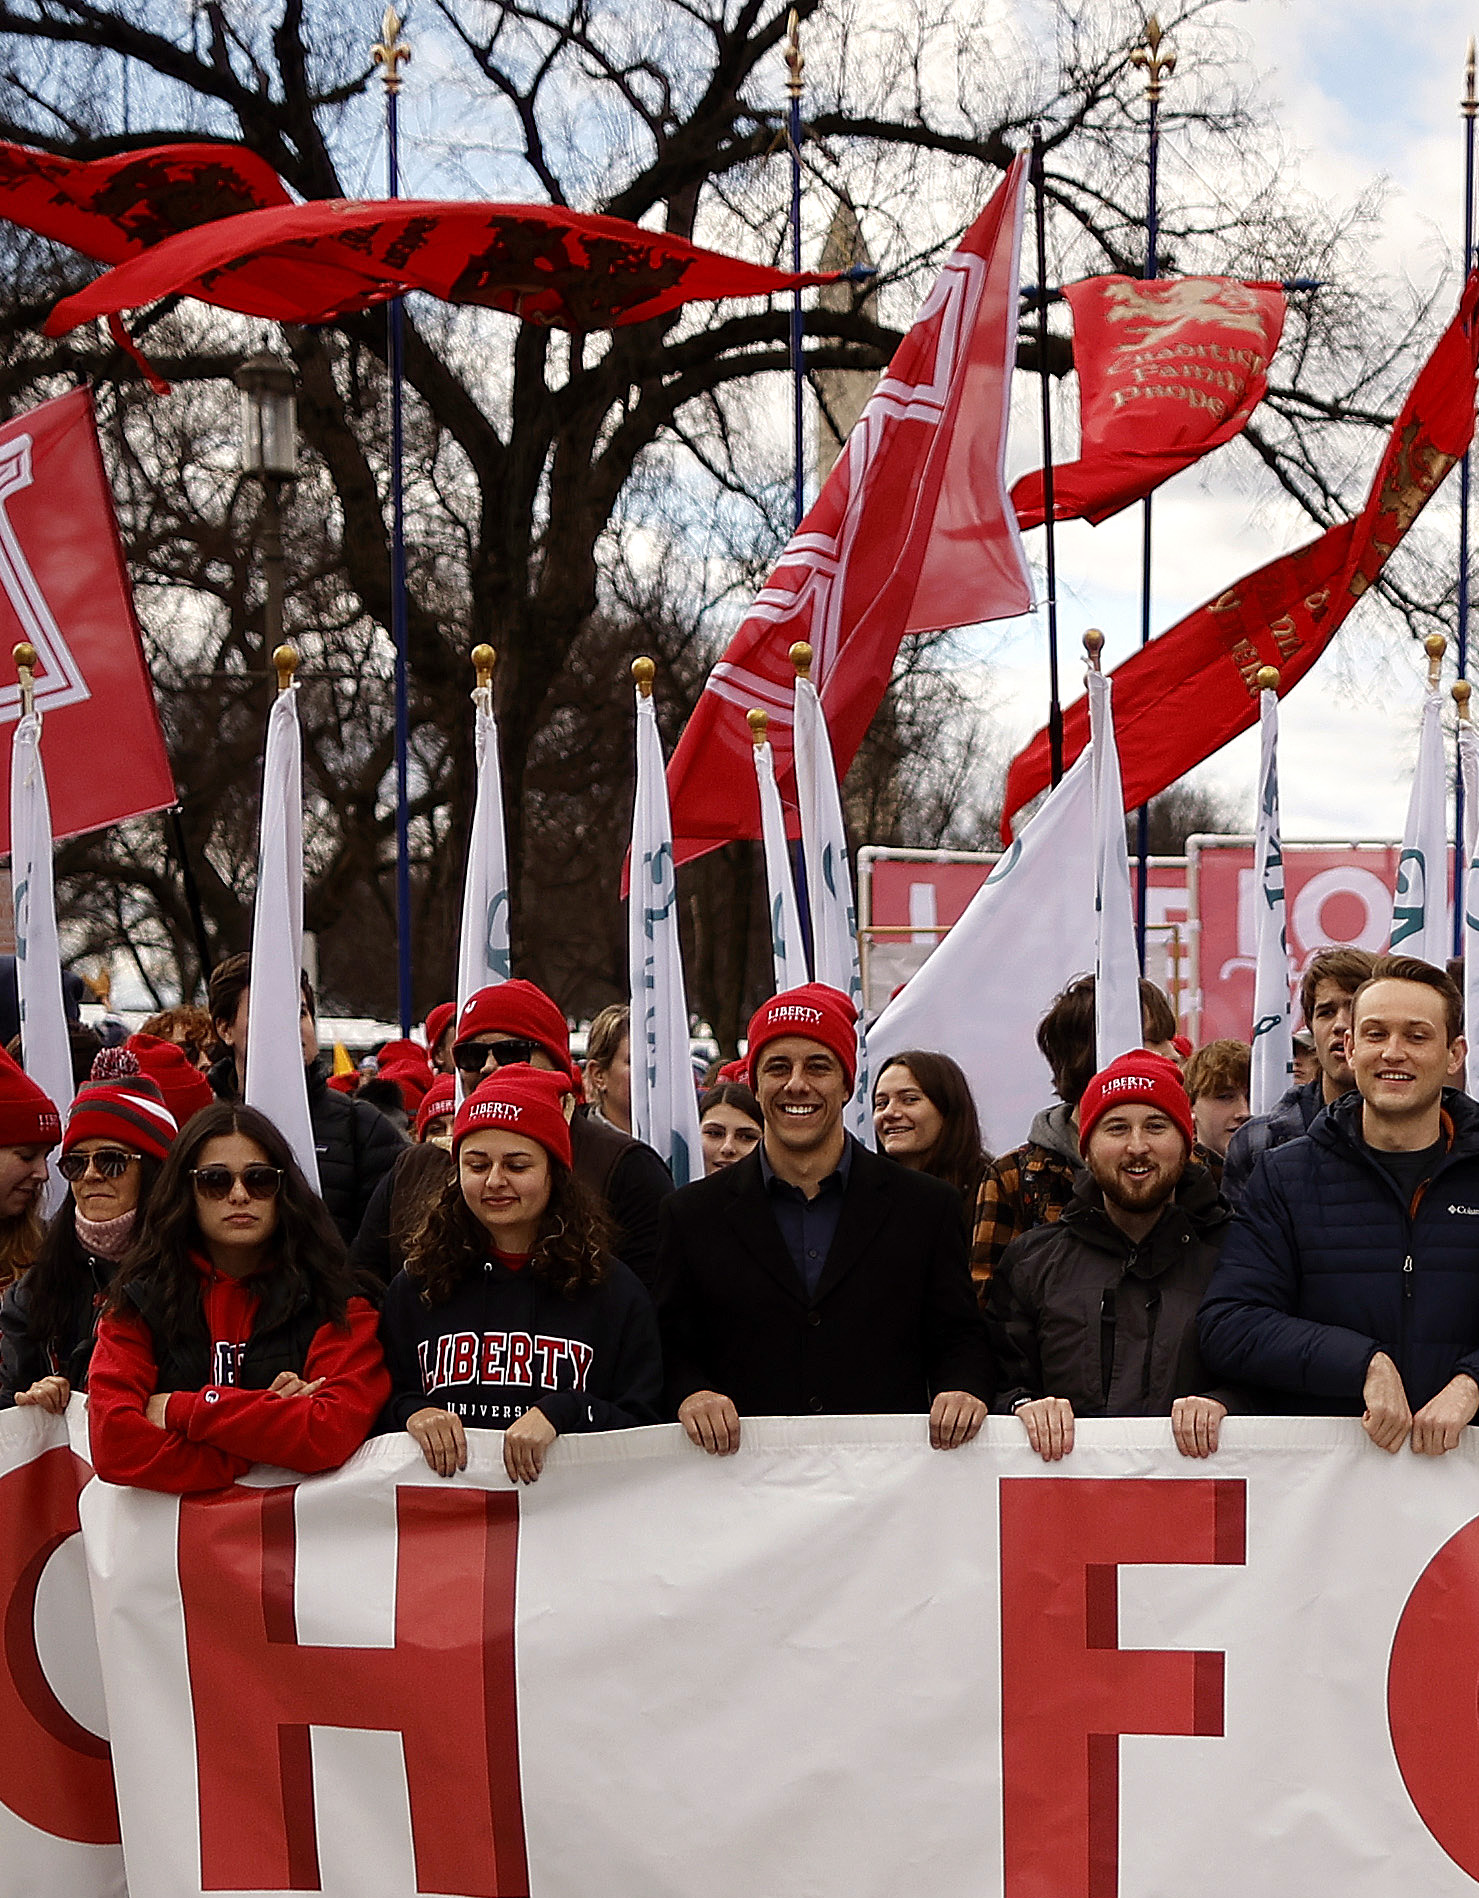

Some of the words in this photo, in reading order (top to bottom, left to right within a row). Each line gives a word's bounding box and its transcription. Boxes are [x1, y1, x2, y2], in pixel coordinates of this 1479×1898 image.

[768, 1006, 823, 1021] LIBERTY
[1101, 1077, 1154, 1095] LIBERTY
[469, 1102, 523, 1118] LIBERTY
[417, 1331, 594, 1396] LIBERTY
